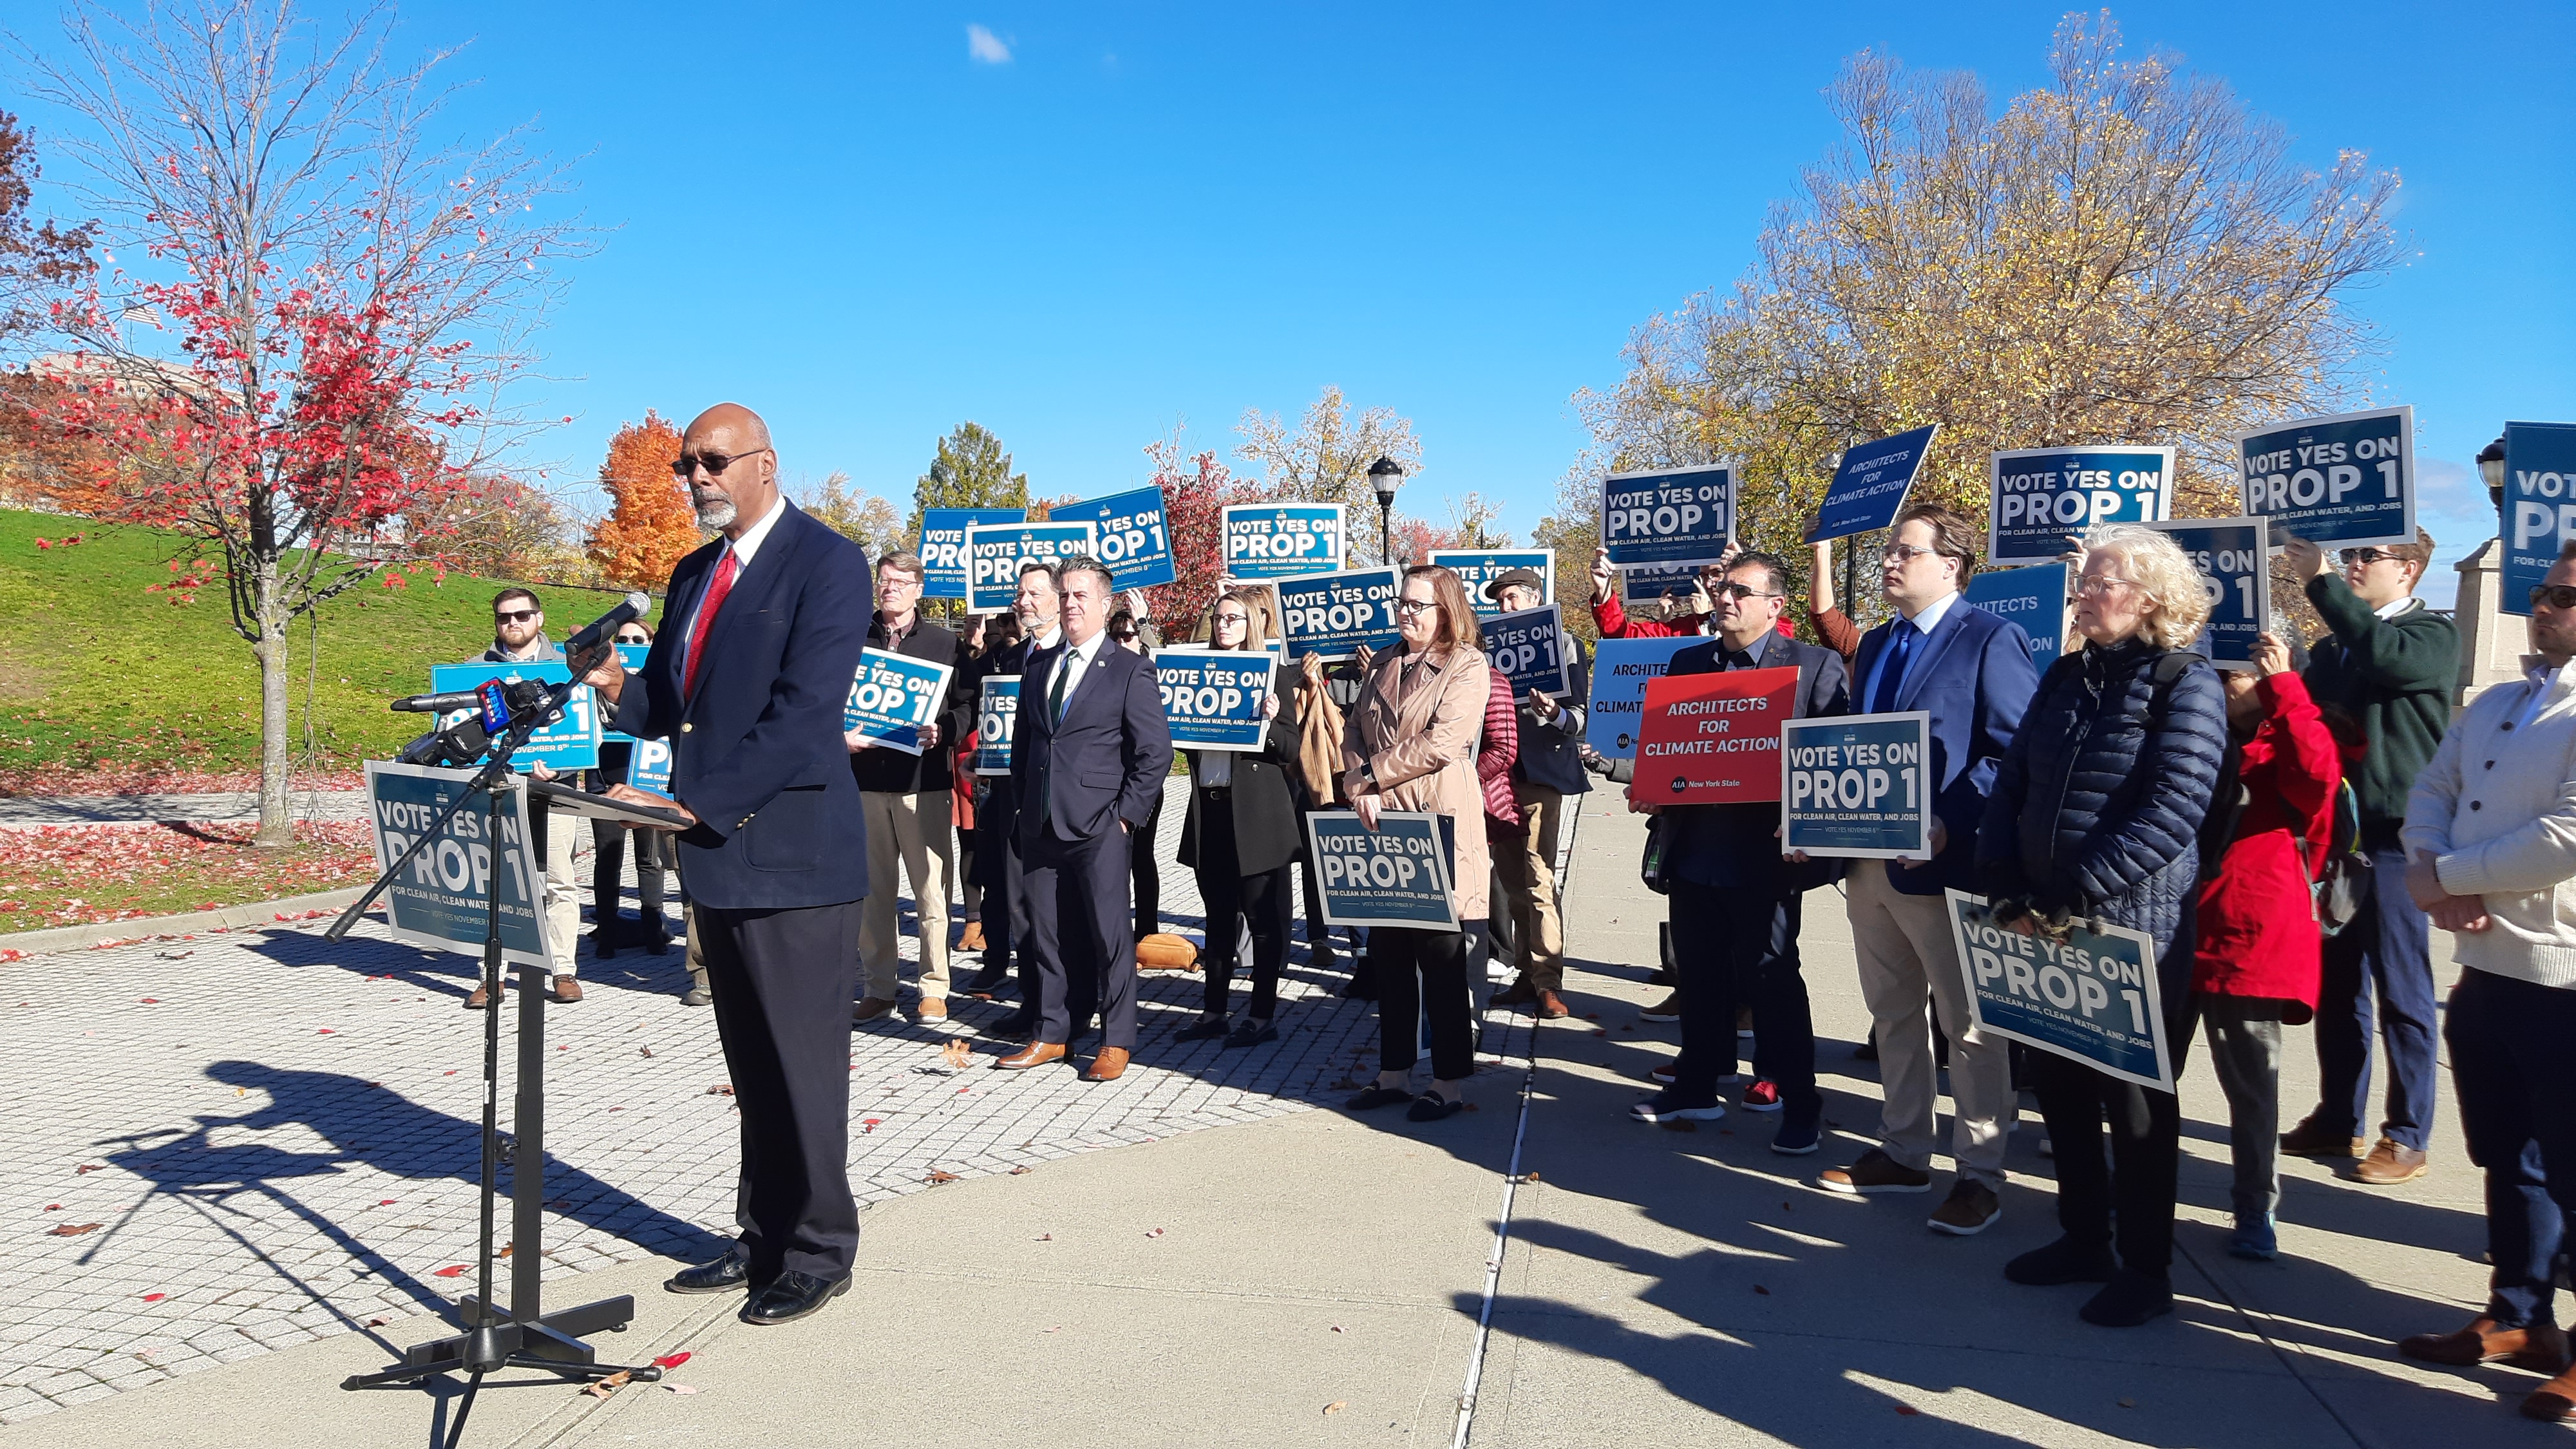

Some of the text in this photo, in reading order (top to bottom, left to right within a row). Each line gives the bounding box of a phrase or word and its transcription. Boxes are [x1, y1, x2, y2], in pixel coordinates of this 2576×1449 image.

[1848, 451, 1909, 475] ARCHITECTS
[2245, 436, 2398, 475] VOTE YES ON
[1861, 471, 1881, 484] FOR
[2001, 471, 2158, 492] VOTE YES ON
[2249, 460, 2397, 514] PROP 1
[1607, 485, 1725, 508] VOTE YES ON
[1826, 479, 1906, 506] CLIMATE ACTION
[1608, 502, 1723, 538] PROP 1
[2002, 490, 2154, 527] PROP 1
[2317, 506, 2352, 515] WATER,
[1101, 510, 1160, 534] YES ON
[1229, 519, 1337, 534] VOTE YES ON
[926, 530, 963, 542] VOTE
[974, 540, 1086, 557] VOTE YES ON
[1150, 525, 1164, 551] 1
[1229, 533, 1336, 558] PROP 1
[2217, 549, 2254, 573] ON
[2514, 556, 2535, 566] FOR
[1282, 584, 1394, 608] VOTE YES ON
[2235, 576, 2253, 618] 1
[1285, 600, 1396, 635] PROP 1
[1497, 630, 1527, 647] YES
[1531, 624, 1555, 640] ON
[1544, 640, 1556, 666] 1
[871, 668, 904, 688] YES
[907, 677, 937, 696] ON
[1157, 669, 1266, 687] VOTE YES ON
[1613, 663, 1668, 676] ARCHITE
[487, 685, 504, 720] WENY
[912, 695, 929, 722] 1
[987, 696, 1017, 711] YES
[1251, 689, 1263, 717] 1
[1596, 701, 1643, 713] CLIMAT
[1667, 697, 1767, 716] ARCHITECTS
[572, 702, 590, 732] 1
[1698, 720, 1729, 734] FOR
[1645, 737, 1779, 757] CLIMATE ACTION
[1790, 743, 1917, 768] VOTE YES ON
[1792, 768, 1915, 809] PROP 1
[377, 799, 431, 831] VOTE
[1859, 813, 1882, 822] WATER,
[1318, 835, 1434, 855] VOTE YES ON
[384, 831, 527, 902] PROP 1
[1323, 855, 1440, 891] PROP 1
[392, 887, 533, 918] FOR CLEAN AIR, CLEAN AND JOBS
[1962, 921, 2142, 988] VOTE YES ON
[1971, 946, 2146, 1035] PROP 1
[1977, 989, 2152, 1050] FOR CLEAN AIR, CLEAN WATER, AND JOBS
[2027, 1016, 2058, 1030] VOTE YES
